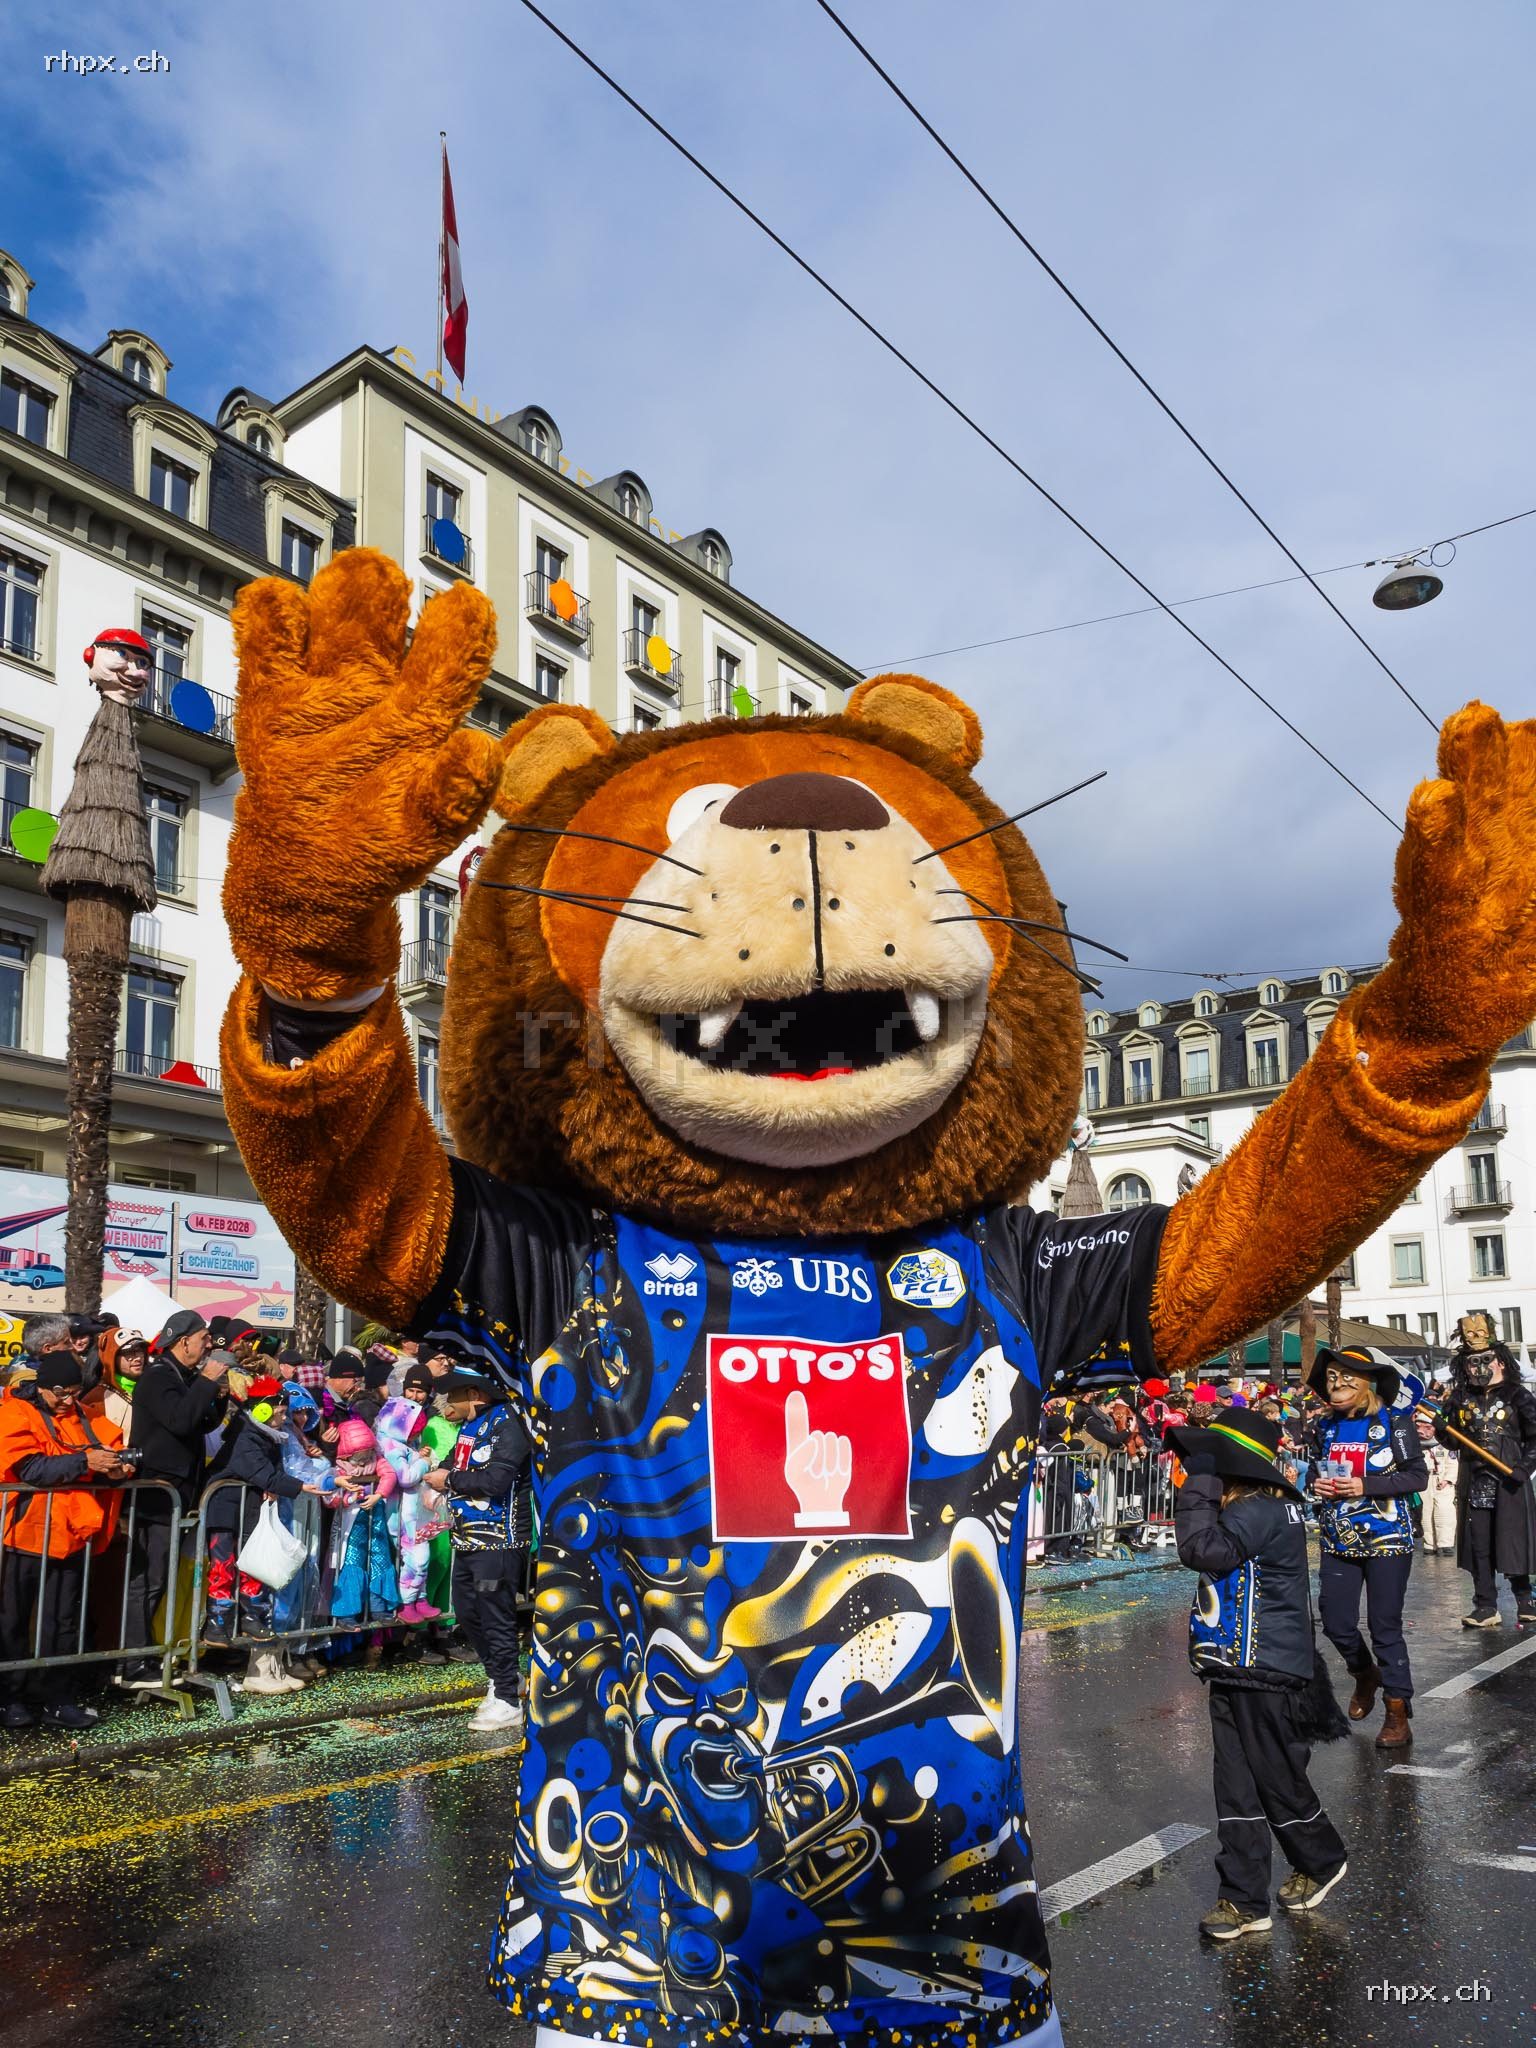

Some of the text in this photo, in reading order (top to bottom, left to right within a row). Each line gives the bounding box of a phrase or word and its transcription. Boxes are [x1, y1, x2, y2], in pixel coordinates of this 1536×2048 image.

[195, 1215, 207, 1229] 14.
[209, 1217, 226, 1231] FEB
[104, 1229, 164, 1250] WERNIGHT
[210, 1246, 234, 1258] Hotel
[188, 1255, 255, 1273] SCHWEIZERHOF
[788, 1257, 873, 1304] UBS
[903, 1278, 955, 1296] FCL
[718, 1343, 895, 1384] OTTO'S
[1331, 1444, 1366, 1453] OTTO'S
